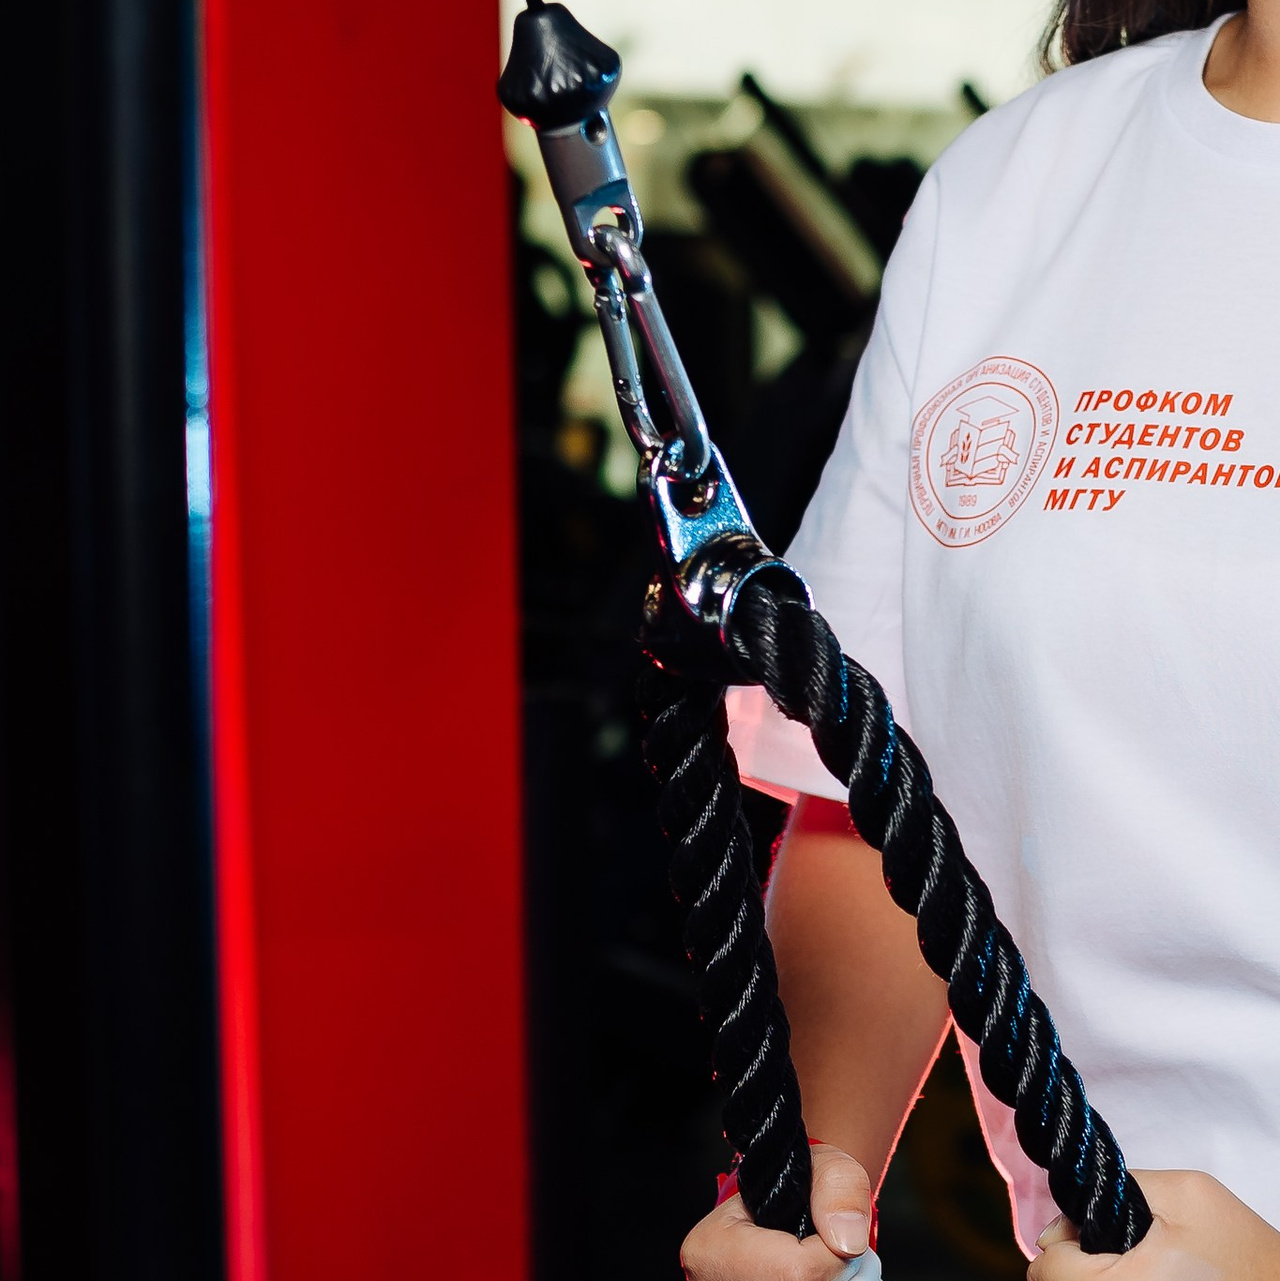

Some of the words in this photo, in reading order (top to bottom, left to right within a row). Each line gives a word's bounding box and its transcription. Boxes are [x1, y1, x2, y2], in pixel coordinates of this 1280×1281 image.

[1028, 377, 1053, 428] СТУДЕНТОВ
[1075, 389, 1233, 417] ПРОФКОМ
[1065, 422, 1245, 453] СТУДЕНТОВ
[1008, 441, 1048, 509] АСПИРАНТОВ
[1053, 456, 1076, 478] И
[1044, 488, 1125, 512] МГТУ
